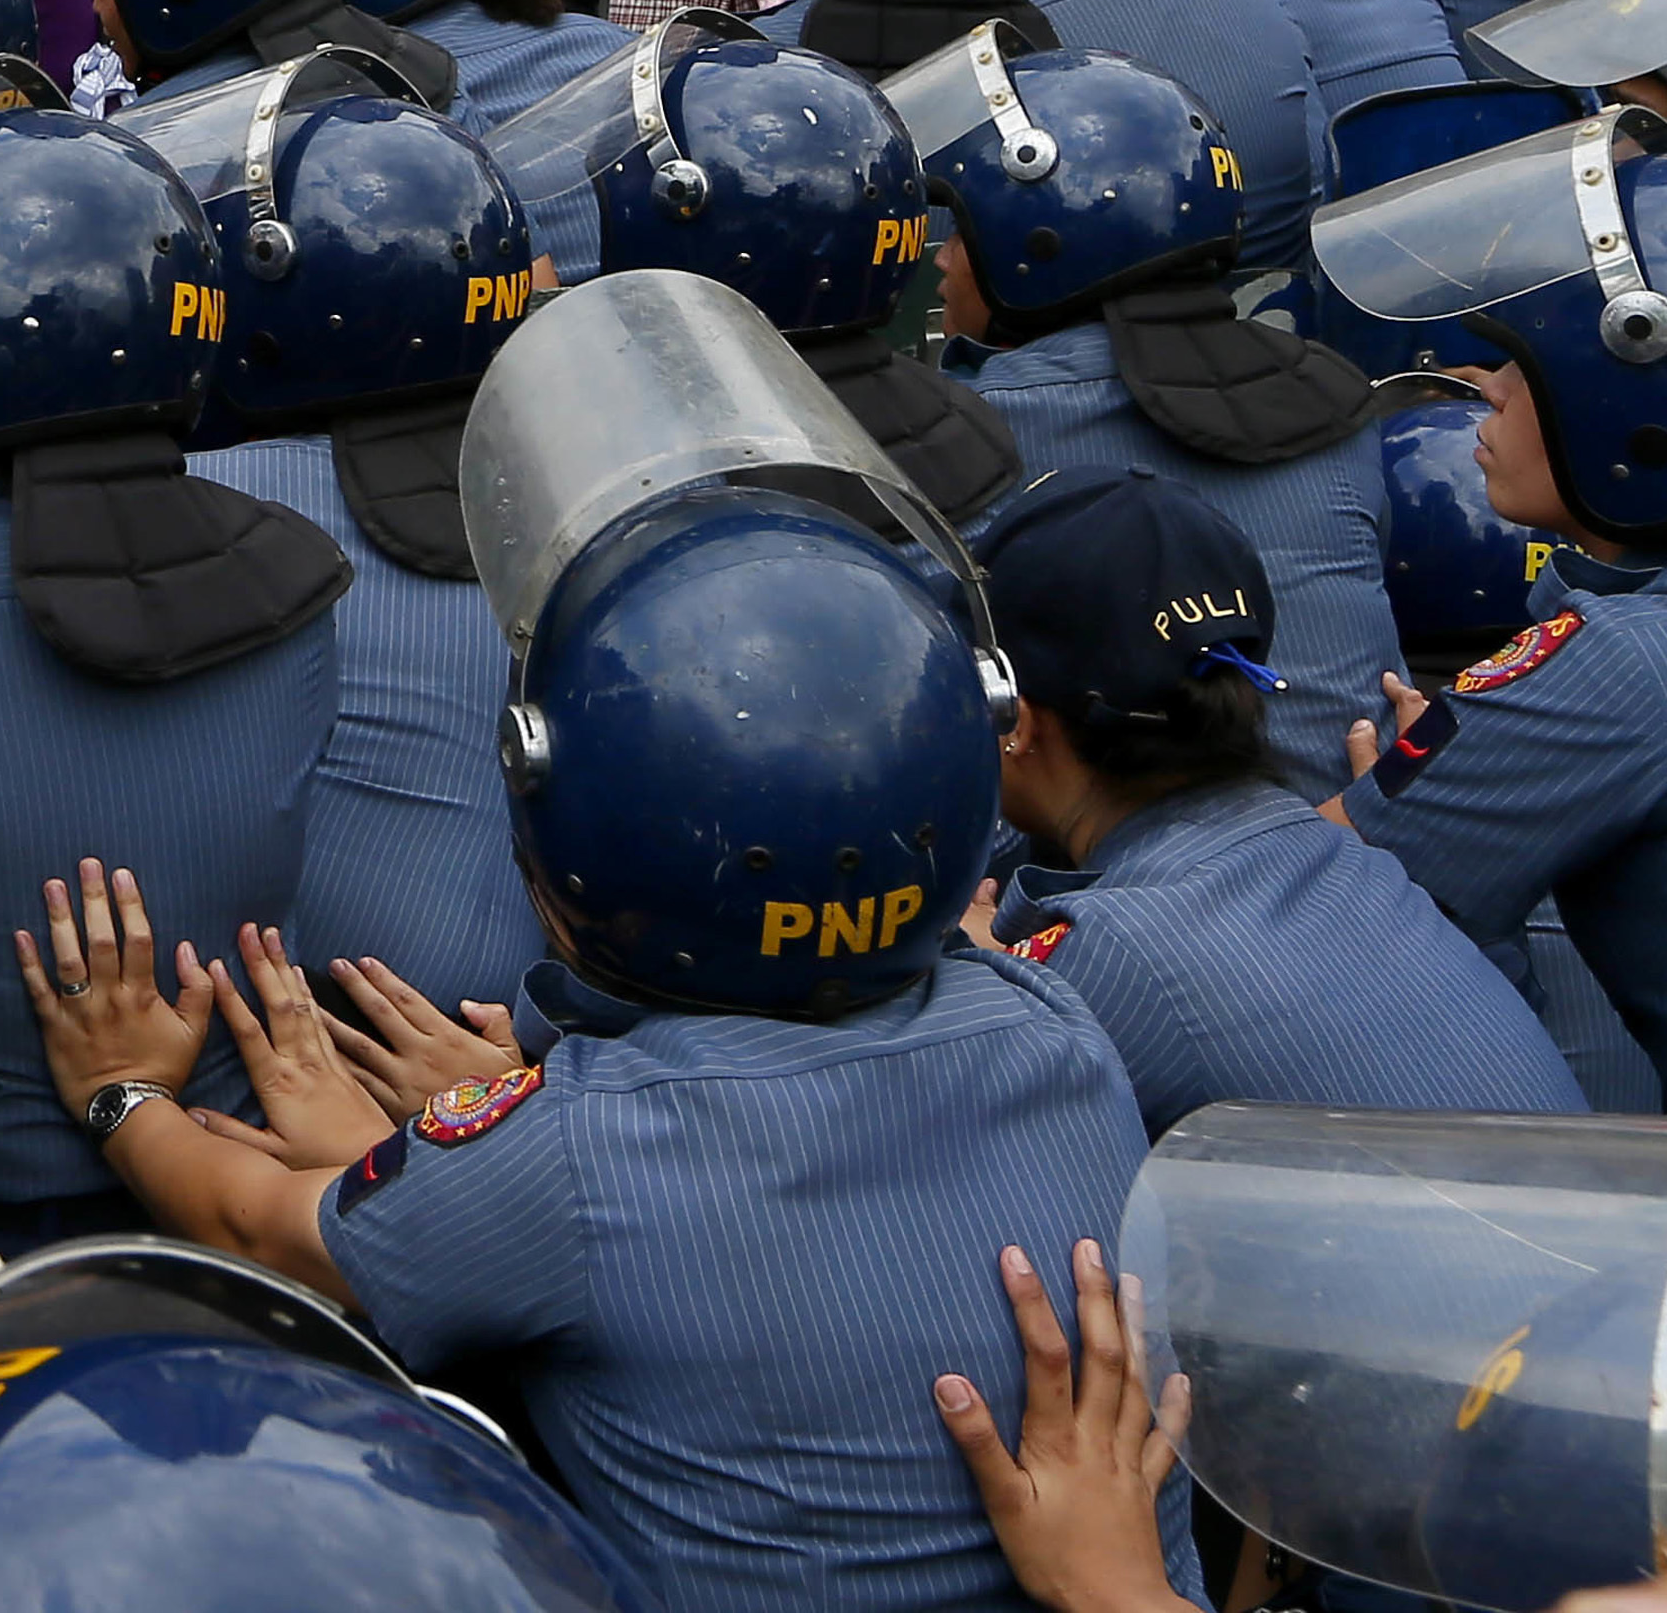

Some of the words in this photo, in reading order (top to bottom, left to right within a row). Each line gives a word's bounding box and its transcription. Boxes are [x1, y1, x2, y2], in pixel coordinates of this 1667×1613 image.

[464, 271, 533, 325] PNP
[1153, 588, 1248, 642] PULI
[760, 884, 925, 959] PNP
